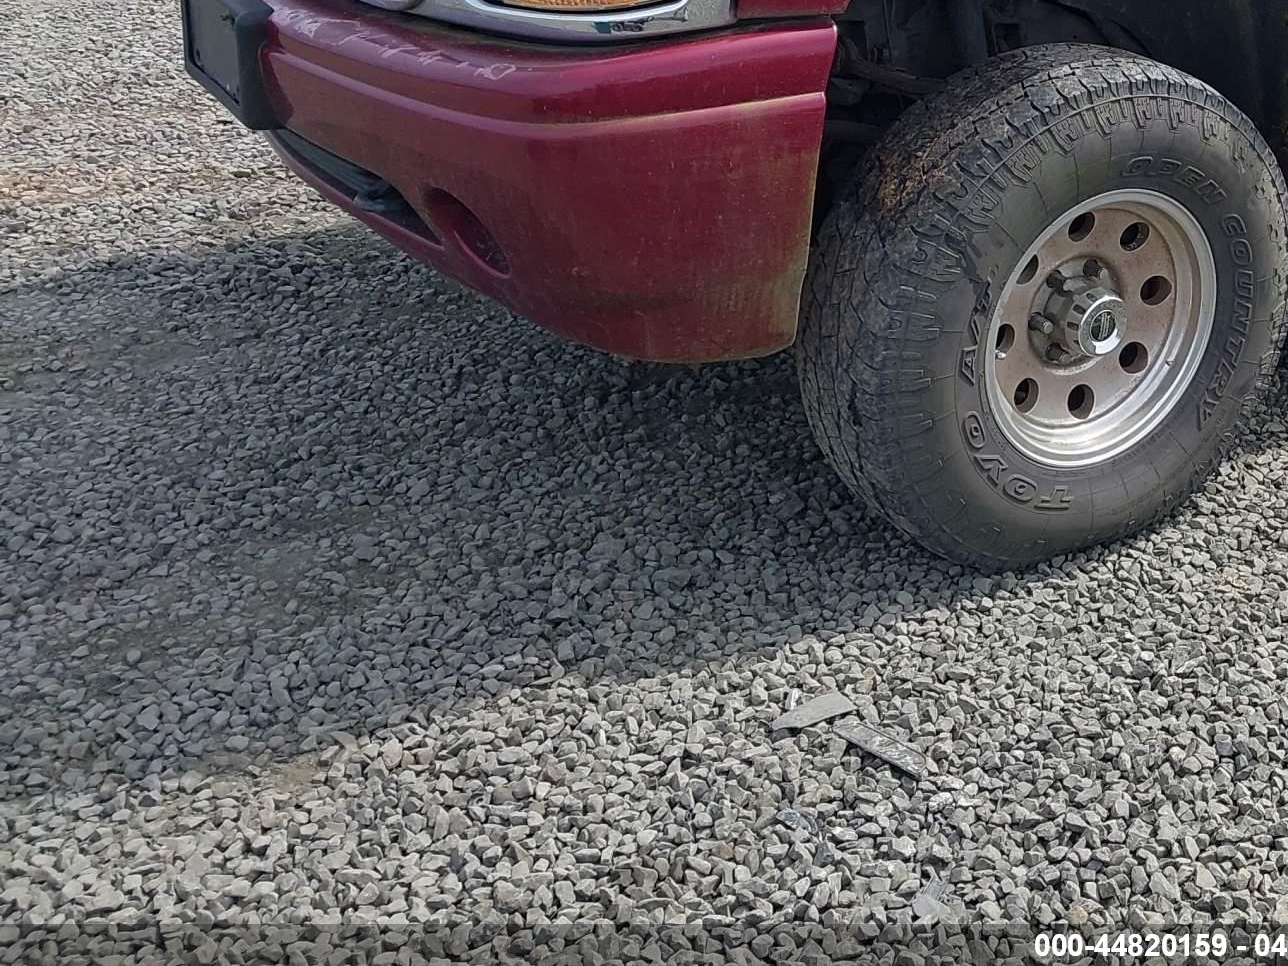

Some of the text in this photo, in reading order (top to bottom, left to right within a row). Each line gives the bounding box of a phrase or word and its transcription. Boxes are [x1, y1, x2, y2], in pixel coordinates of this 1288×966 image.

[1121, 155, 1257, 431] OPEN COUNTRY
[962, 410, 1074, 510] TOYO
